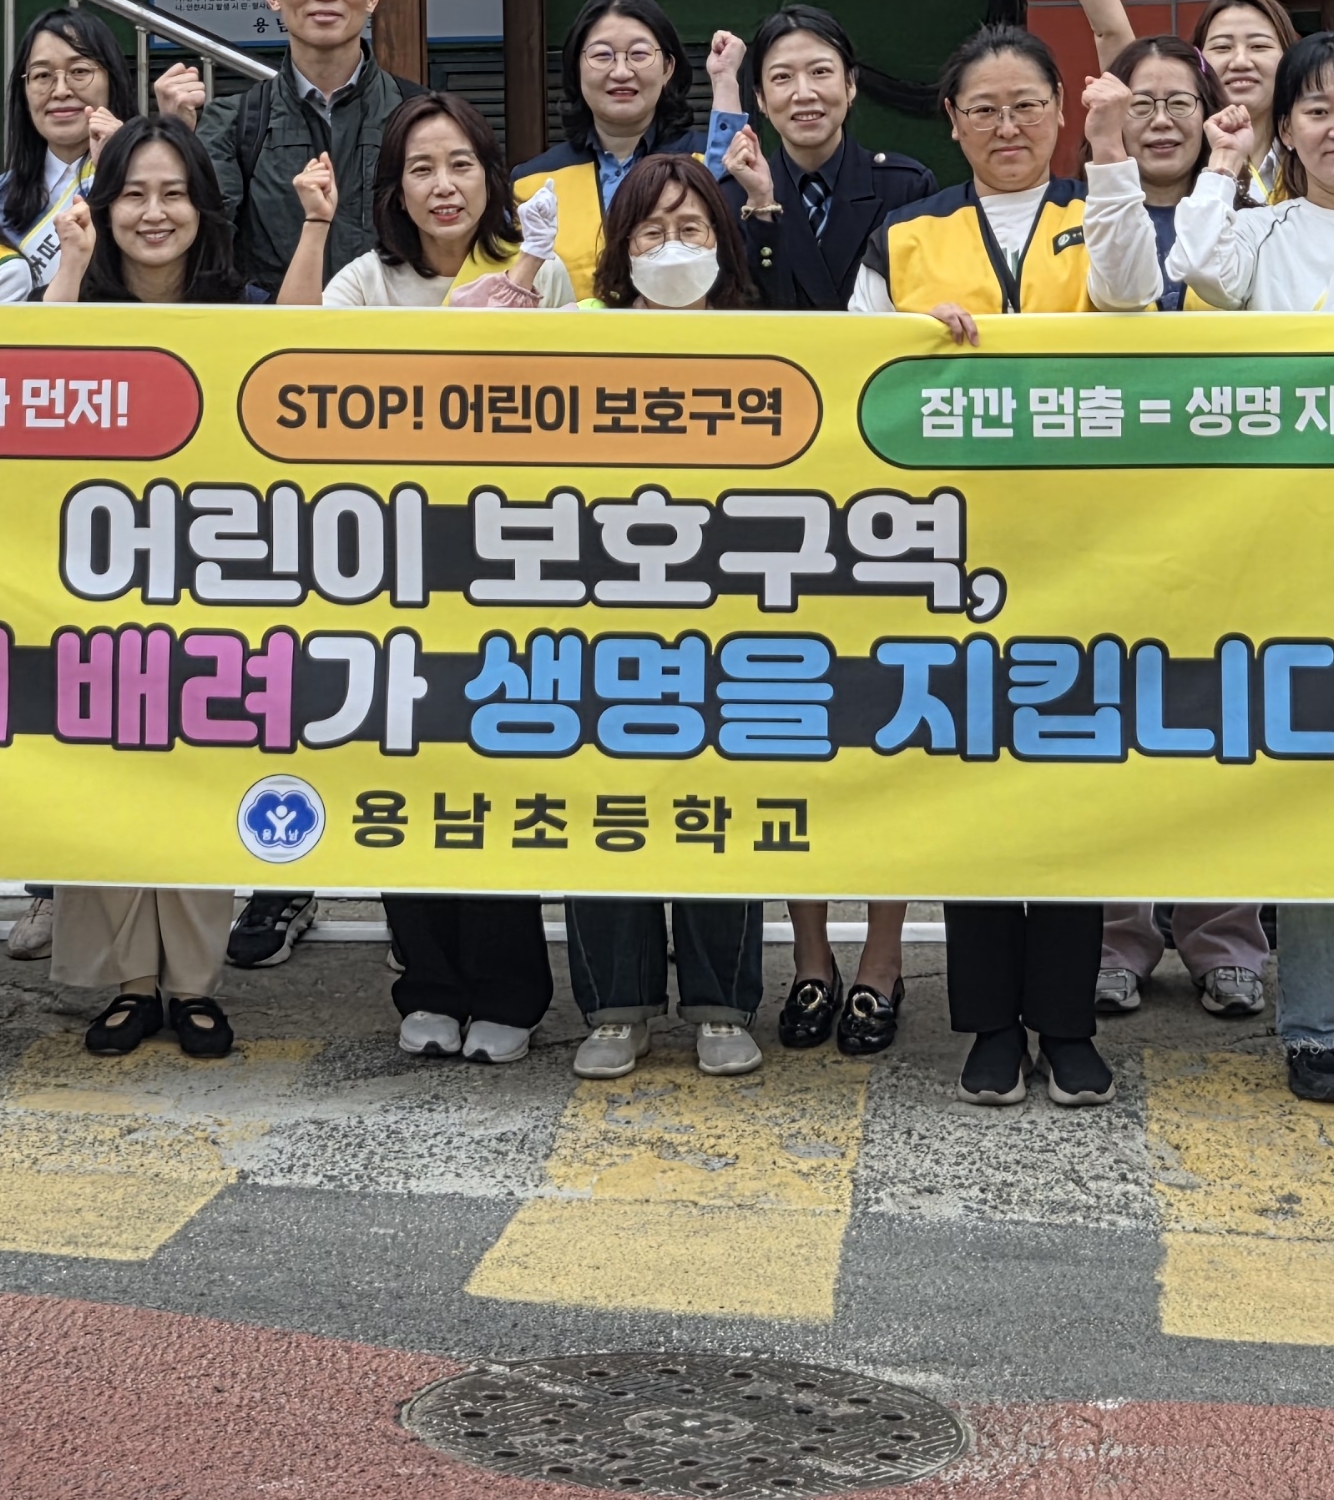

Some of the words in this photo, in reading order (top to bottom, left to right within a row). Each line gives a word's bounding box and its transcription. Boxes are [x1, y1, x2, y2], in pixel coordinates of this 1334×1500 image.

[20, 377, 128, 429] 먼저!
[275, 382, 424, 431] STOP!
[439, 383, 579, 433] 어린이
[592, 386, 783, 437] 보호구역
[921, 386, 1017, 438] 잠깐
[1028, 386, 1126, 438] 멈춤
[1186, 385, 1282, 437] 생명
[60, 478, 429, 608] 어린이
[465, 482, 1008, 623] 보호구역,
[50, 622, 428, 758] 배려가
[464, 627, 838, 760] 생명을
[351, 790, 812, 855] 용남초등학교
